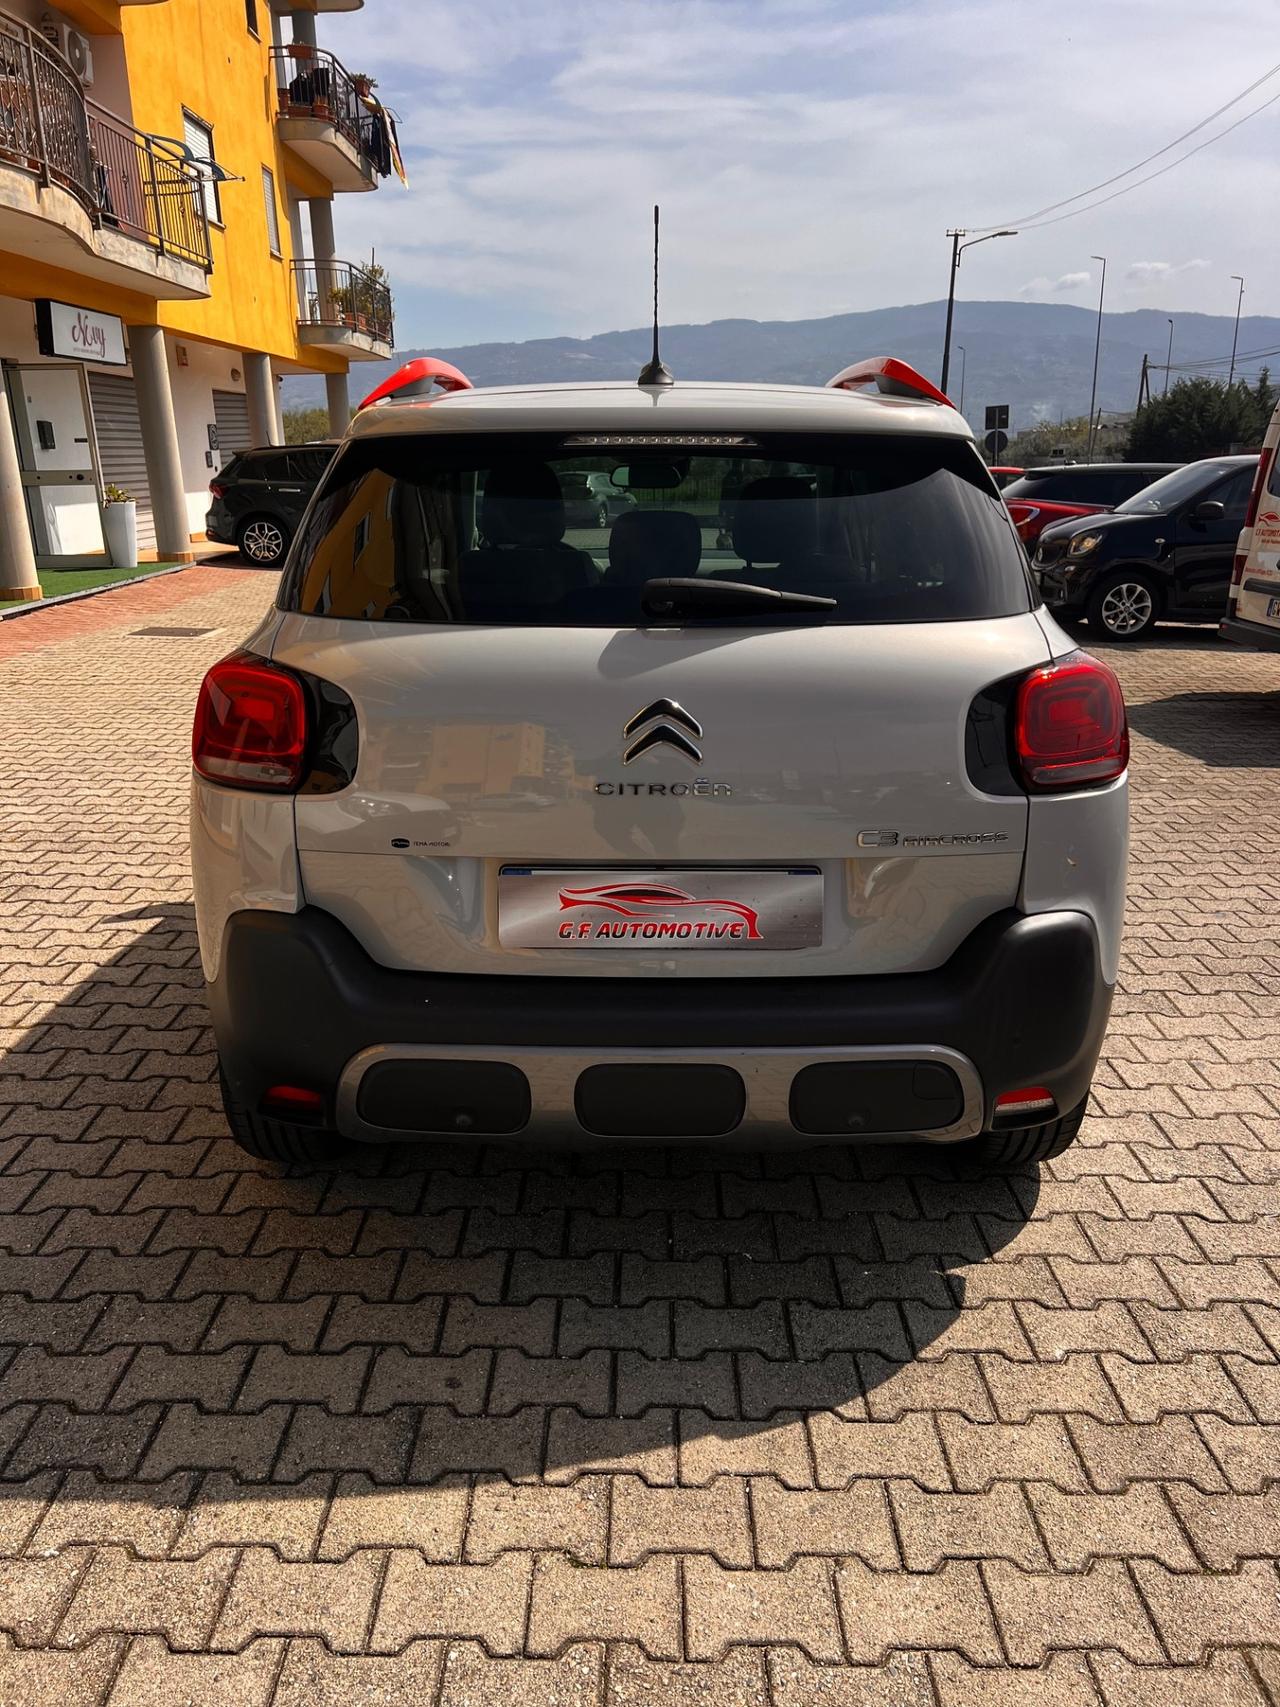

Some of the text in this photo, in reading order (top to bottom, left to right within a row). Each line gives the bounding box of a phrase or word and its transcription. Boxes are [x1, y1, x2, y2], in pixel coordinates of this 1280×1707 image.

[595, 777, 733, 797] CITROËN
[857, 830, 1008, 848] C3 AIRCROSS
[594, 922, 745, 939] AUTOMOTIVE
